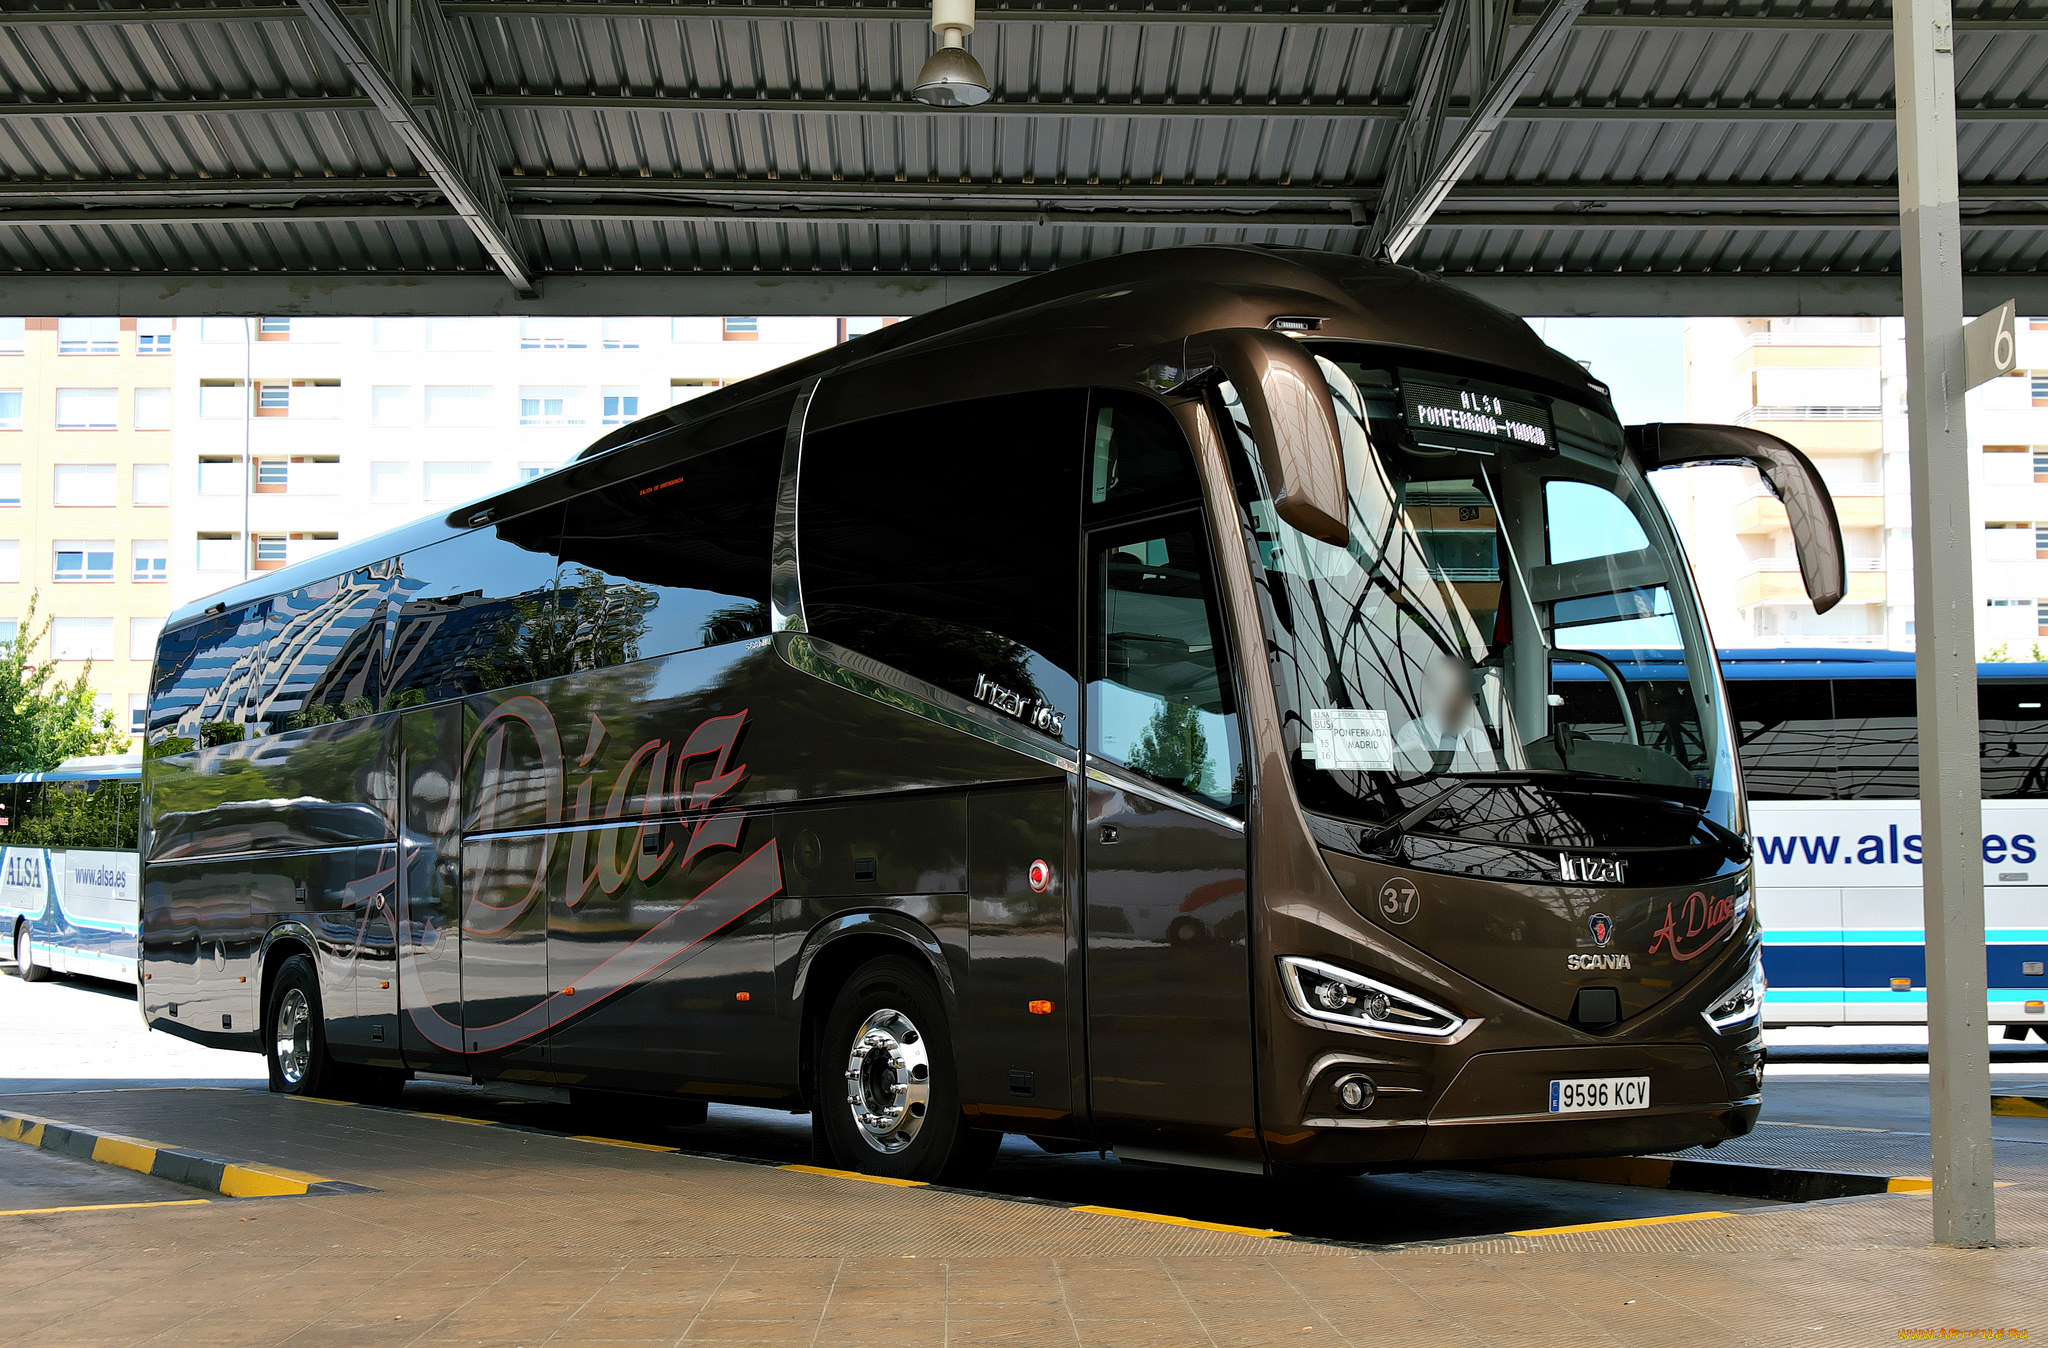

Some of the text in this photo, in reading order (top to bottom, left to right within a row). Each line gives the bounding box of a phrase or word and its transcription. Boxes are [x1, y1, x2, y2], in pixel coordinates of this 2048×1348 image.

[1994, 305, 2013, 370] 6
[1460, 390, 1502, 416] ALSA
[974, 672, 1067, 736] Irizar i6s
[1314, 719, 1332, 729] BUS
[1333, 728, 1388, 738] PONFERRADA
[1320, 739, 1330, 748] 15
[1347, 740, 1380, 750] MADRID
[1321, 752, 1331, 761] 16
[6, 856, 42, 888] ALSA
[75, 864, 127, 889] www.alsa.es
[1559, 851, 1629, 884] Irizar
[1383, 888, 1416, 916] 37
[1567, 953, 1632, 971] SCANIA
[1563, 1083, 1609, 1108] 9596
[1614, 1081, 1646, 1105] KCV
